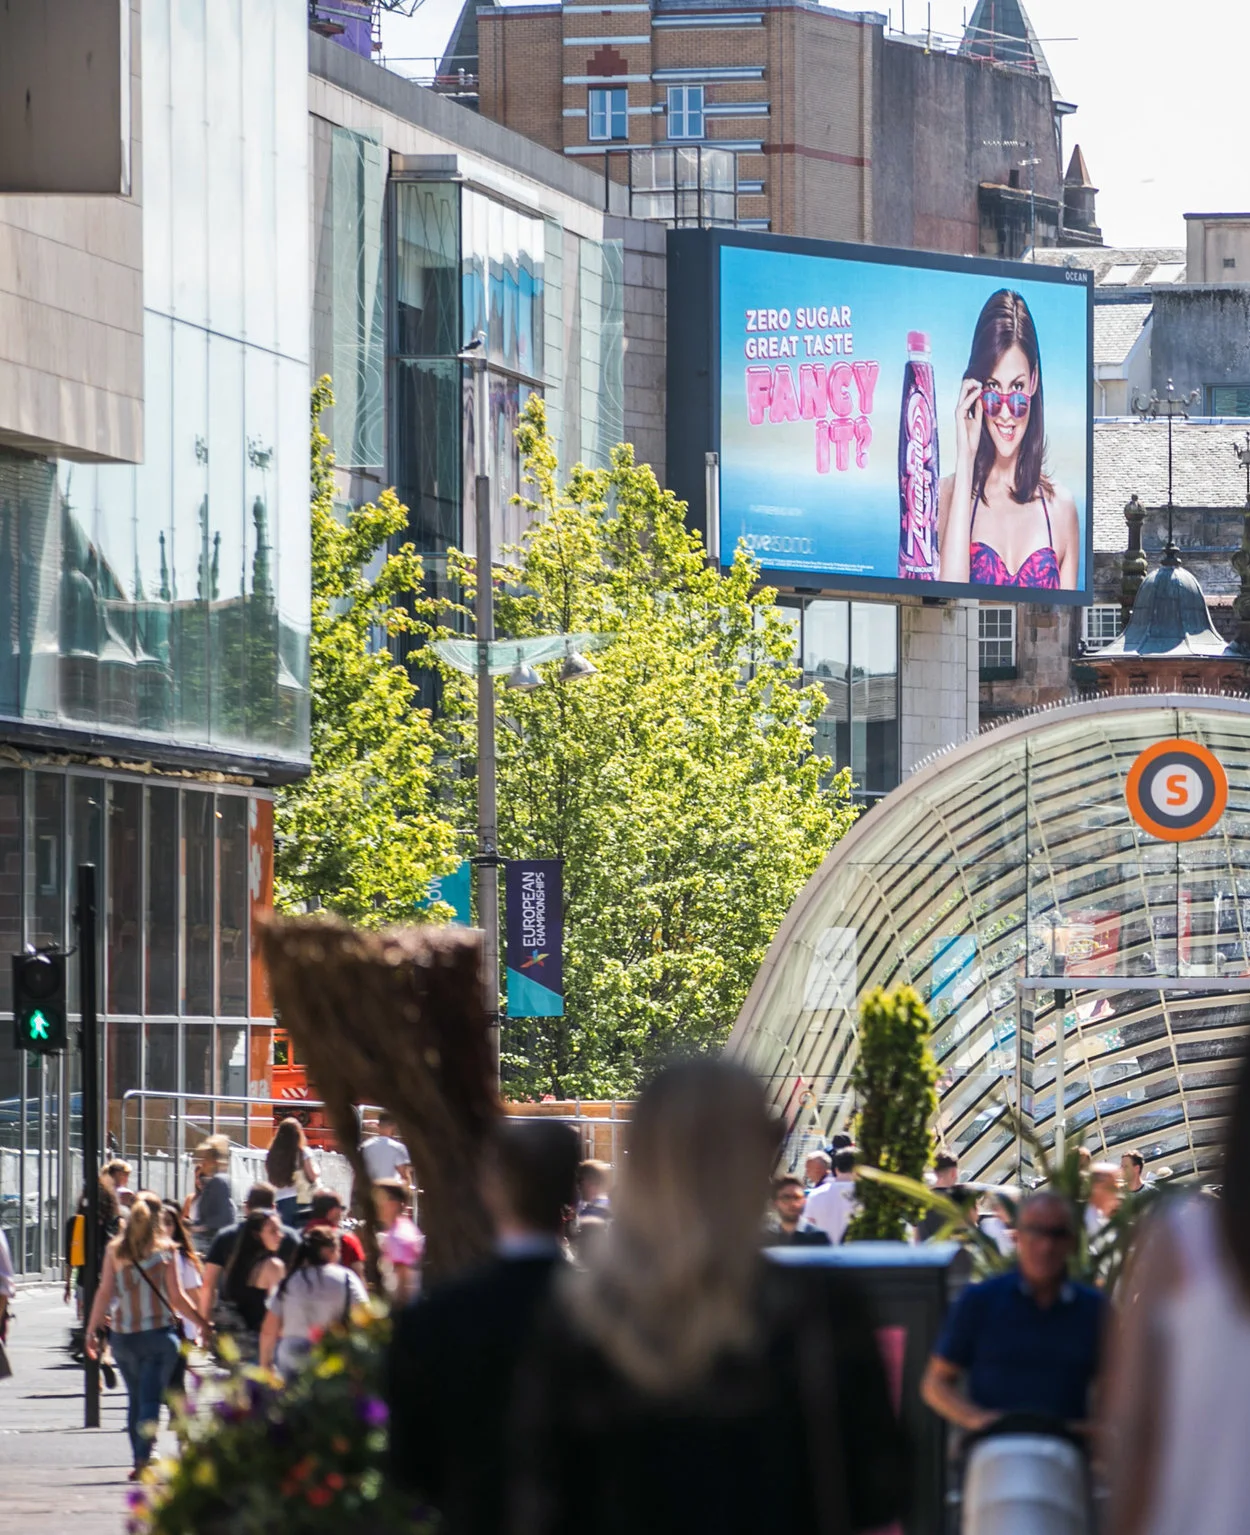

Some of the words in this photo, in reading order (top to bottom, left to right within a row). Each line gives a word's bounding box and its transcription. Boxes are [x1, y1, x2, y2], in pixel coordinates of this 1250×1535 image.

[1065, 271, 1088, 283] OCEAN
[745, 308, 791, 332] ZERO
[795, 305, 852, 330] SUGAR
[744, 335, 799, 360] GREAT
[803, 333, 854, 356] TASTE
[746, 360, 880, 425] FANCY
[815, 415, 873, 474] IT?
[1166, 774, 1189, 806] S
[521, 871, 536, 947] EUROPEAN
[535, 871, 546, 947] CHAMPIONSHIPS
